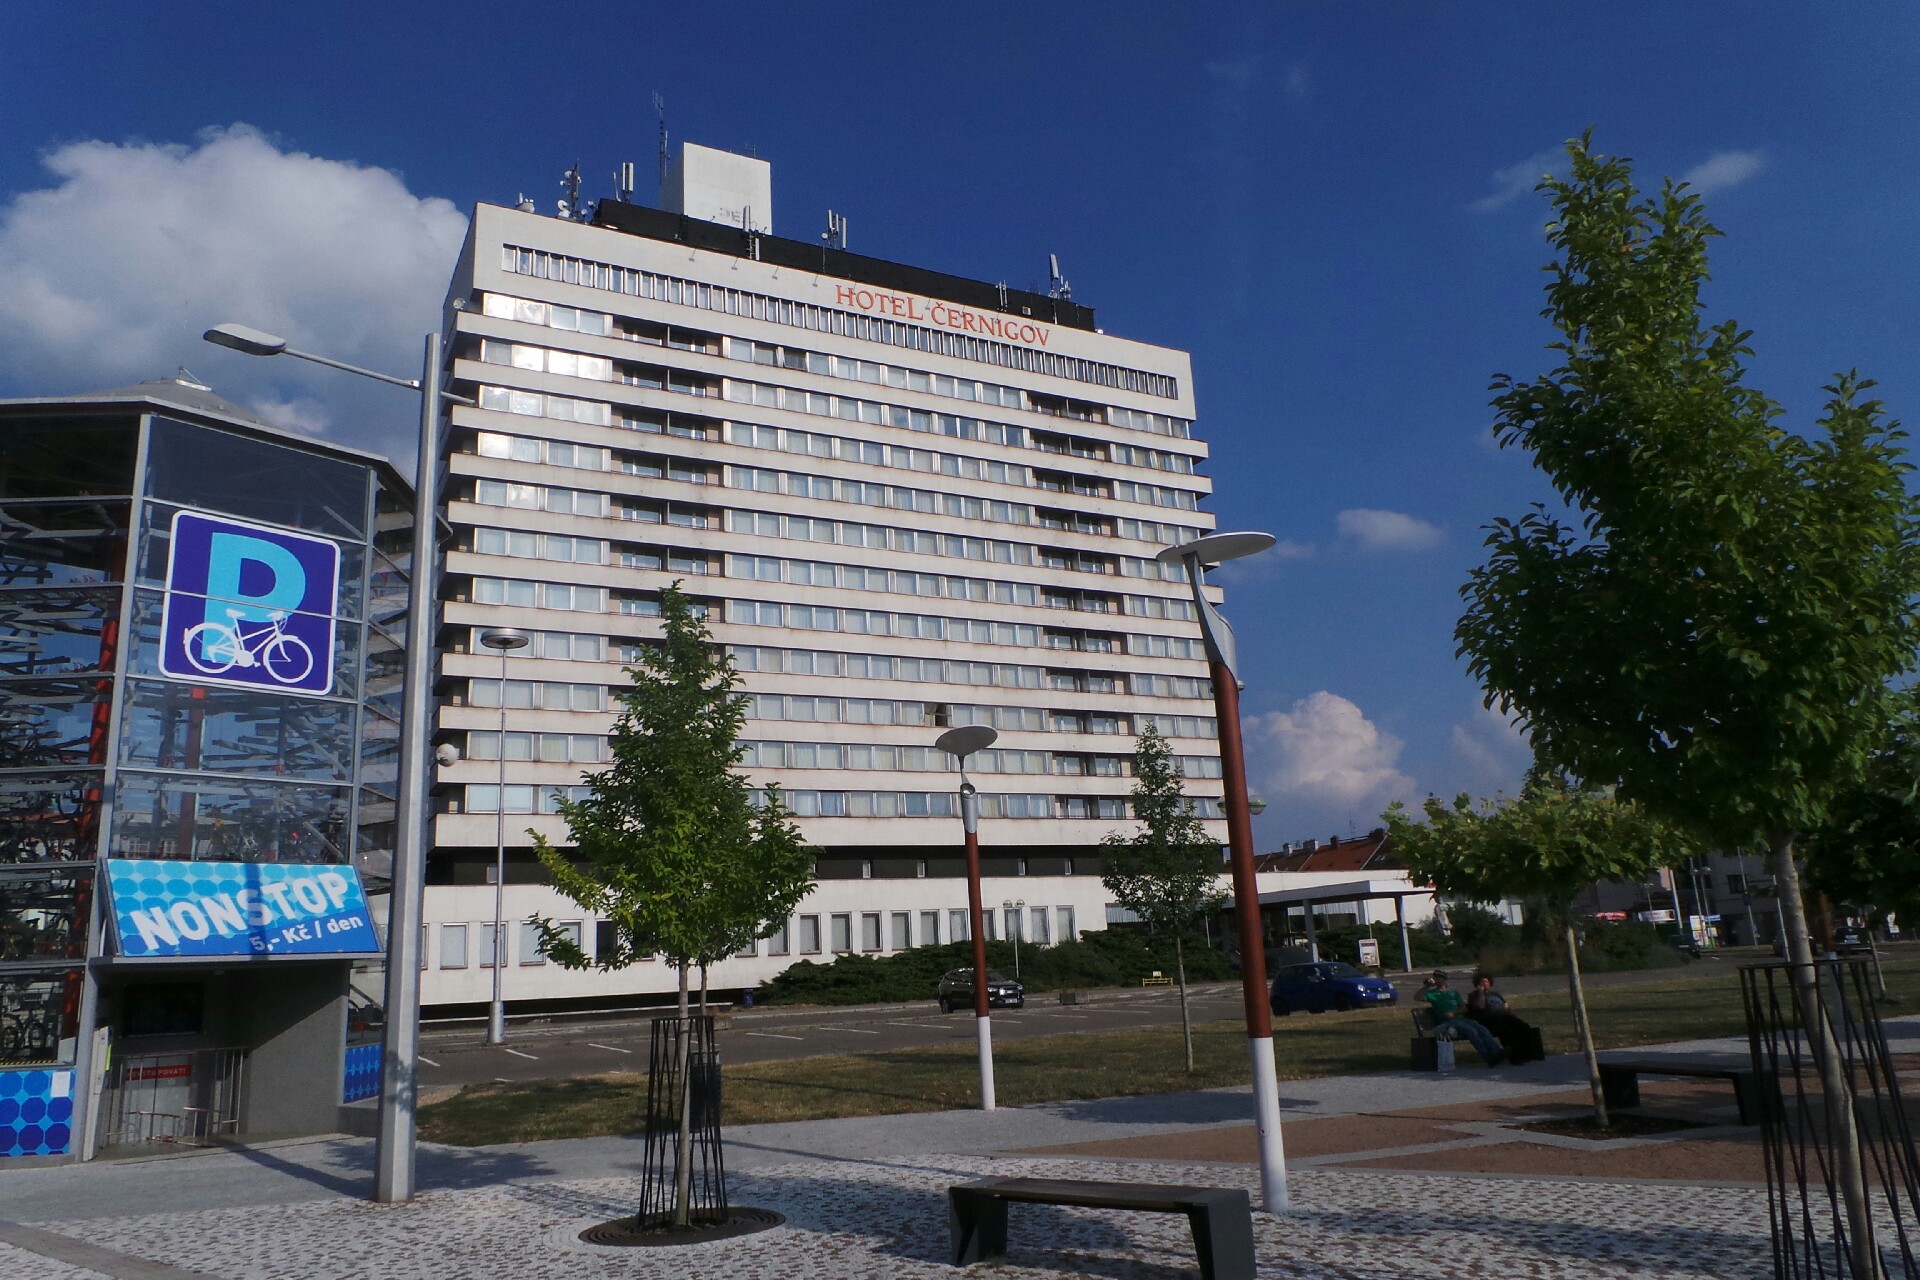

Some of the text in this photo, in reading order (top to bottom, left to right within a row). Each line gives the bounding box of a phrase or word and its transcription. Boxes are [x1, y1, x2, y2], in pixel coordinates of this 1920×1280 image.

[836, 285, 1050, 346] HOTEL ČERNIGOV
[201, 532, 306, 664] P
[130, 873, 348, 950] NONSTOP
[283, 924, 312, 943] Kč
[327, 916, 363, 934] den
